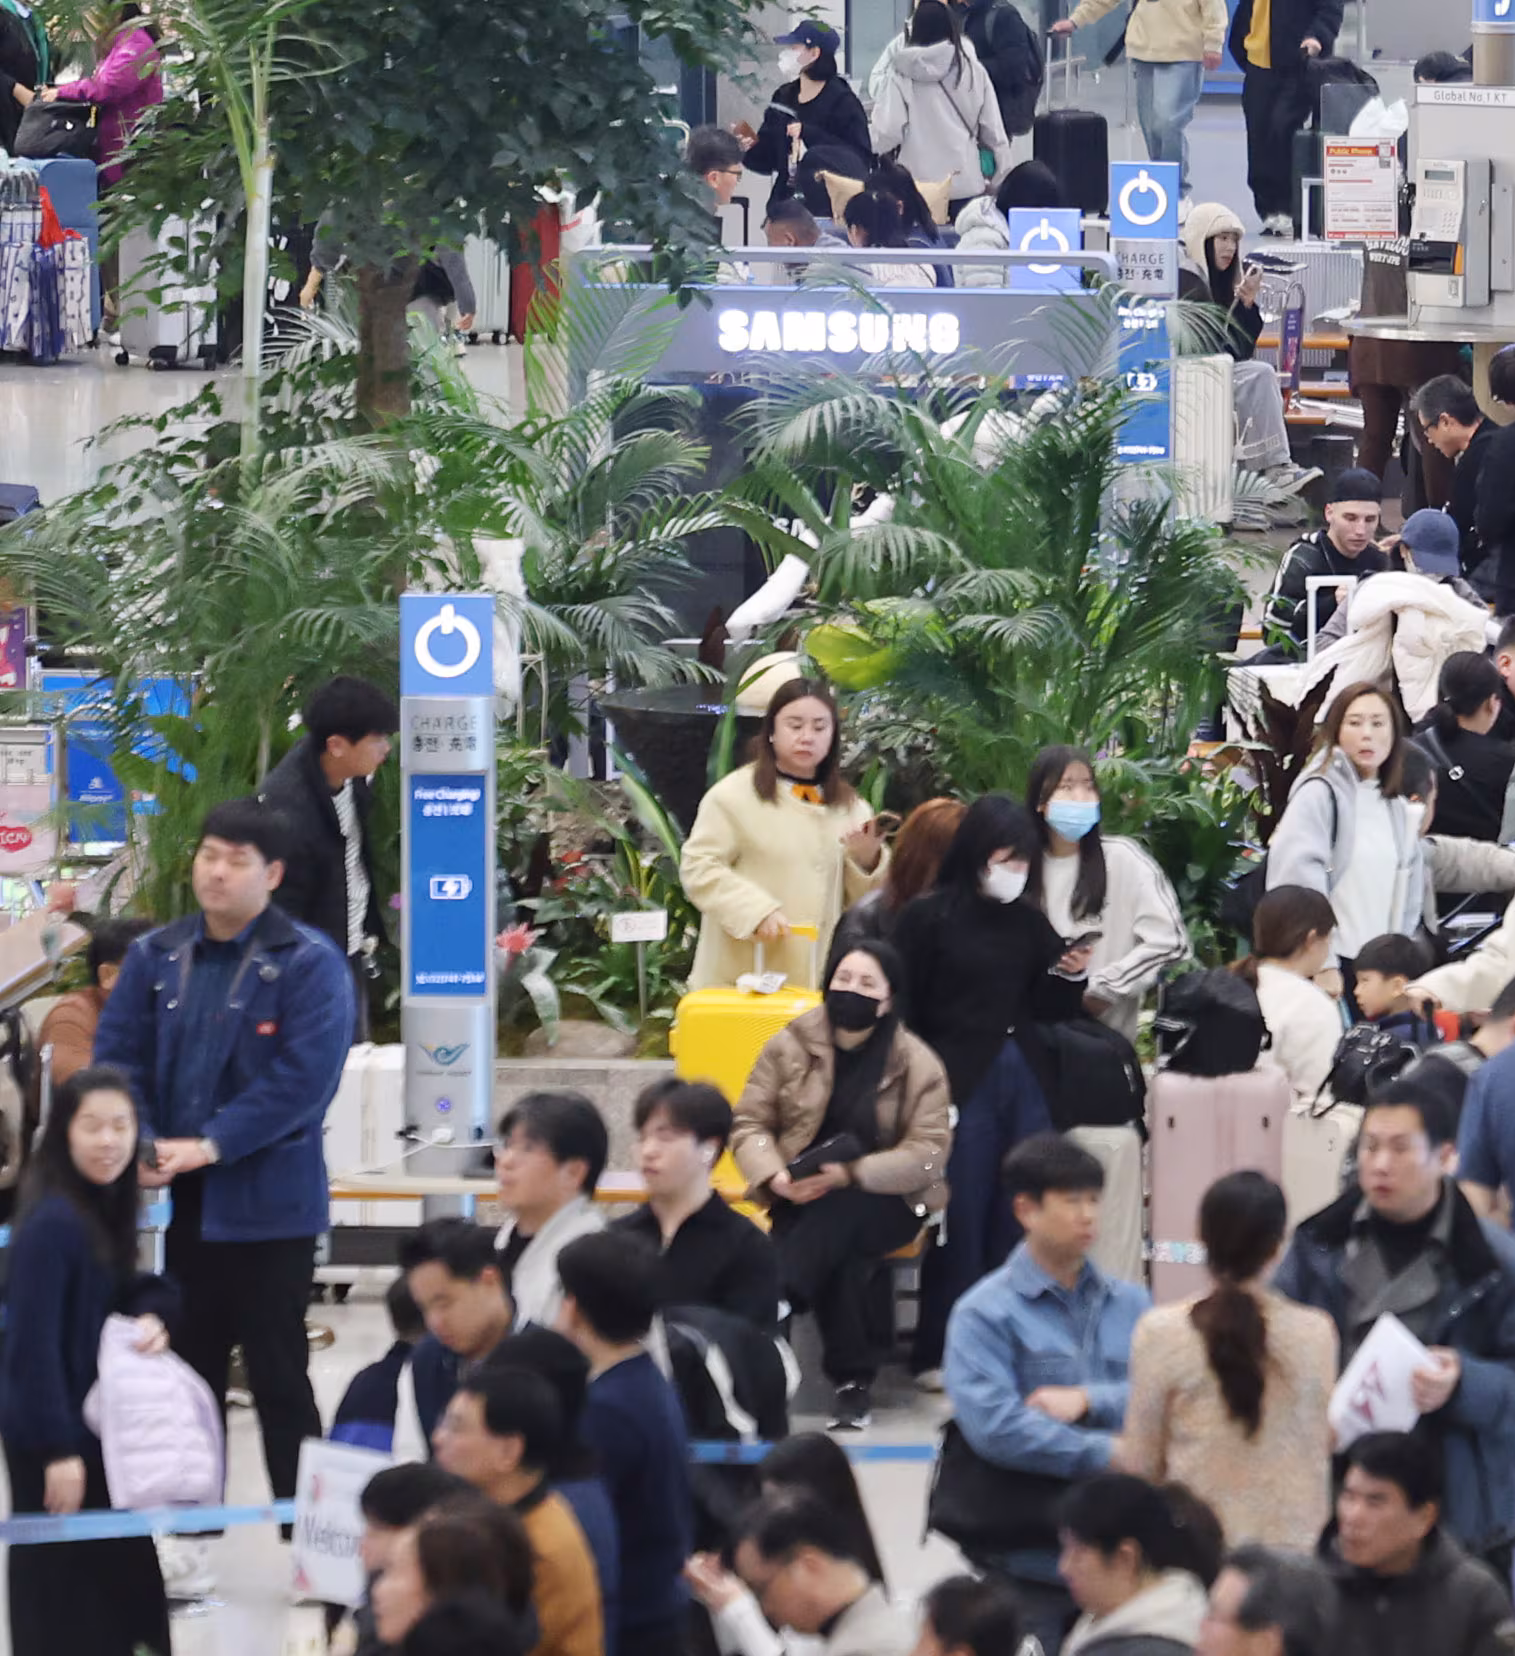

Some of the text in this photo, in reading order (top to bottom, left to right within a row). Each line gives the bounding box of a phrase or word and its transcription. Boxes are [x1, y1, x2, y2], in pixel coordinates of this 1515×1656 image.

[1434, 90, 1465, 102] Global
[1494, 93, 1507, 103] KT
[718, 309, 960, 354] SAMSUNG
[410, 715, 478, 731] CHARGE
